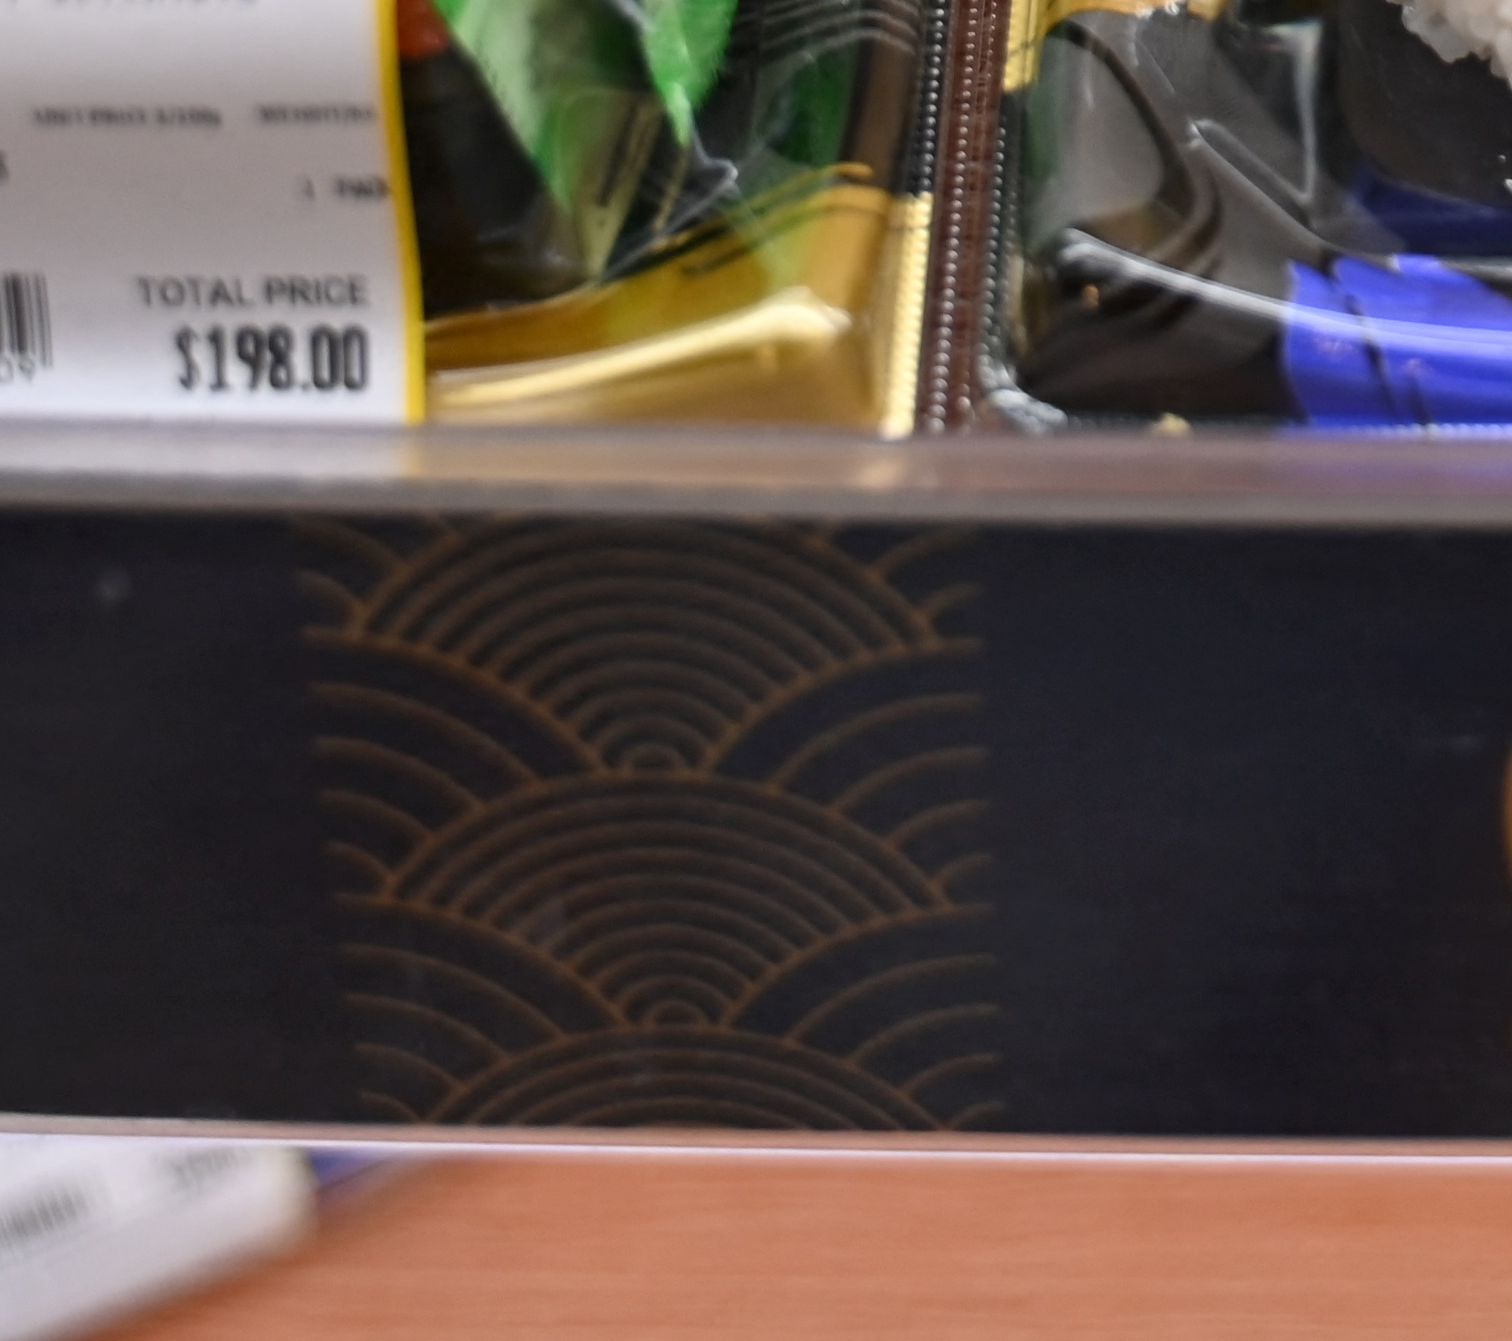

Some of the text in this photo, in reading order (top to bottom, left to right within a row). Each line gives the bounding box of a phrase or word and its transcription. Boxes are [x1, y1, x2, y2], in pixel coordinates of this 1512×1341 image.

[136, 274, 368, 308] TOTAL PRICE
[174, 323, 370, 393] $198.00
